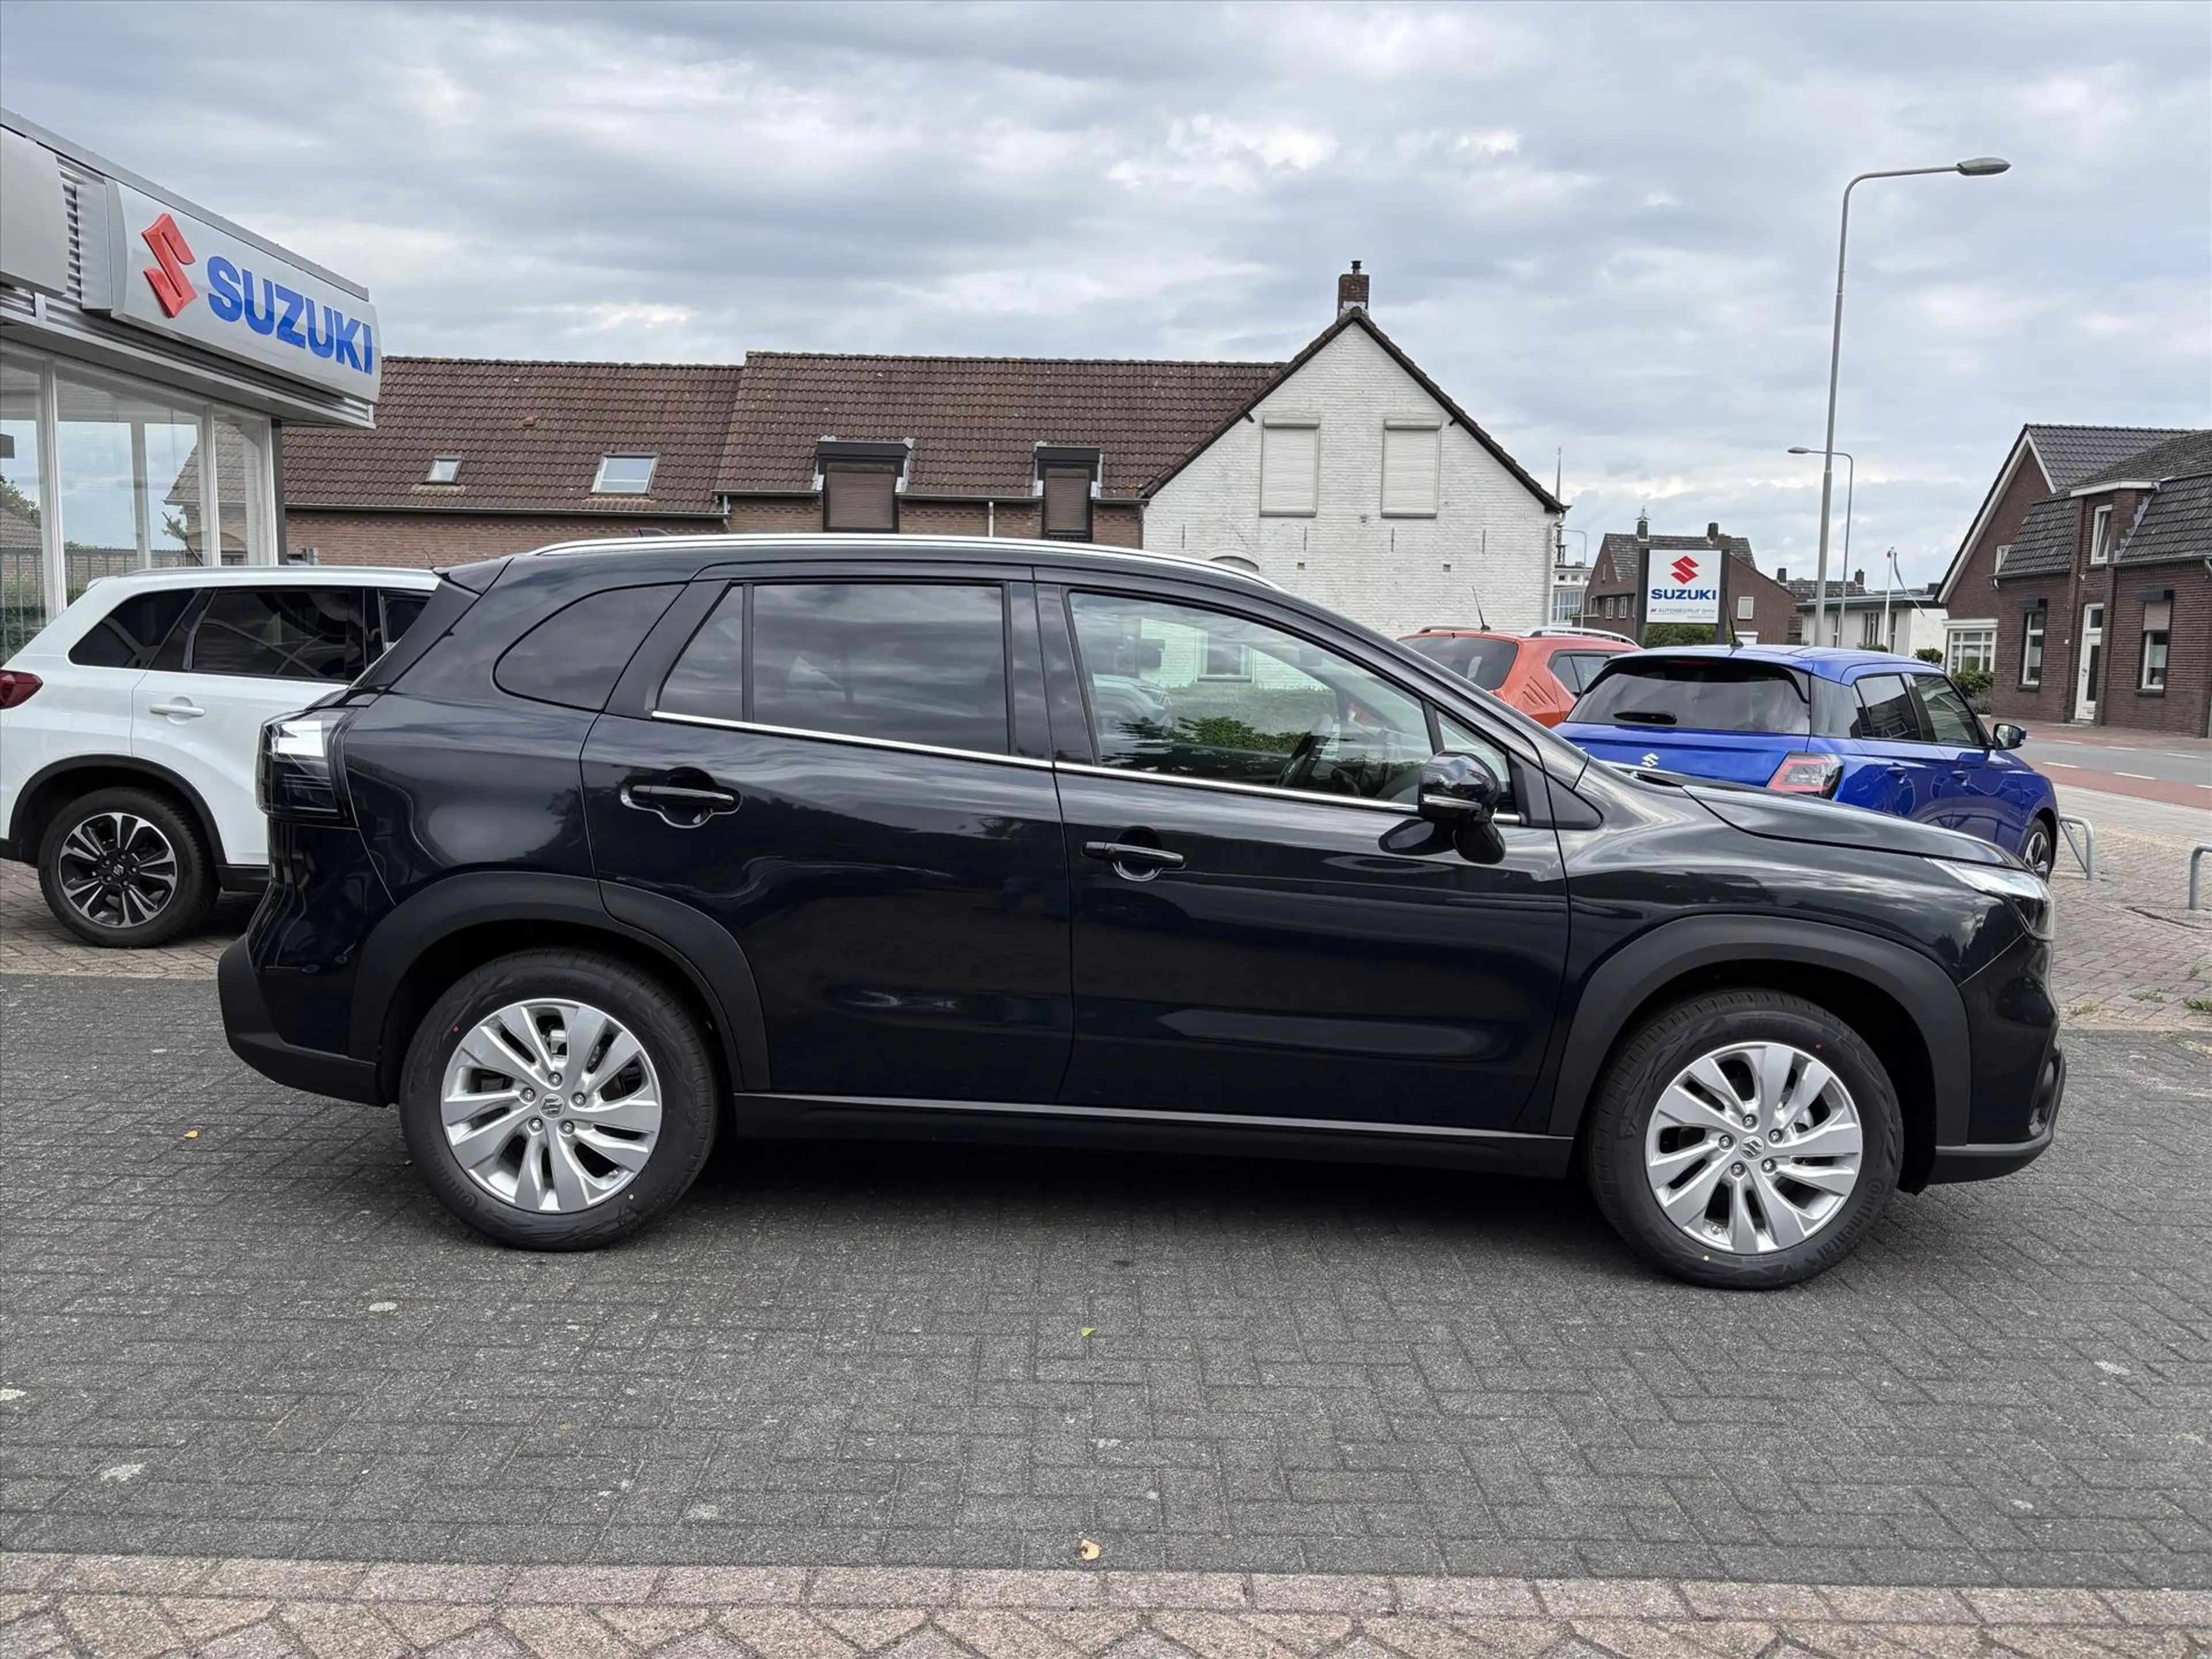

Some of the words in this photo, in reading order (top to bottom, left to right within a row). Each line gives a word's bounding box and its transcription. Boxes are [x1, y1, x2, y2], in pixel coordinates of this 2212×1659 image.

[207, 256, 373, 376] SUZUKI
[1650, 588, 1717, 600] SUZUKI
[1816, 1177, 1885, 1261] Continental
